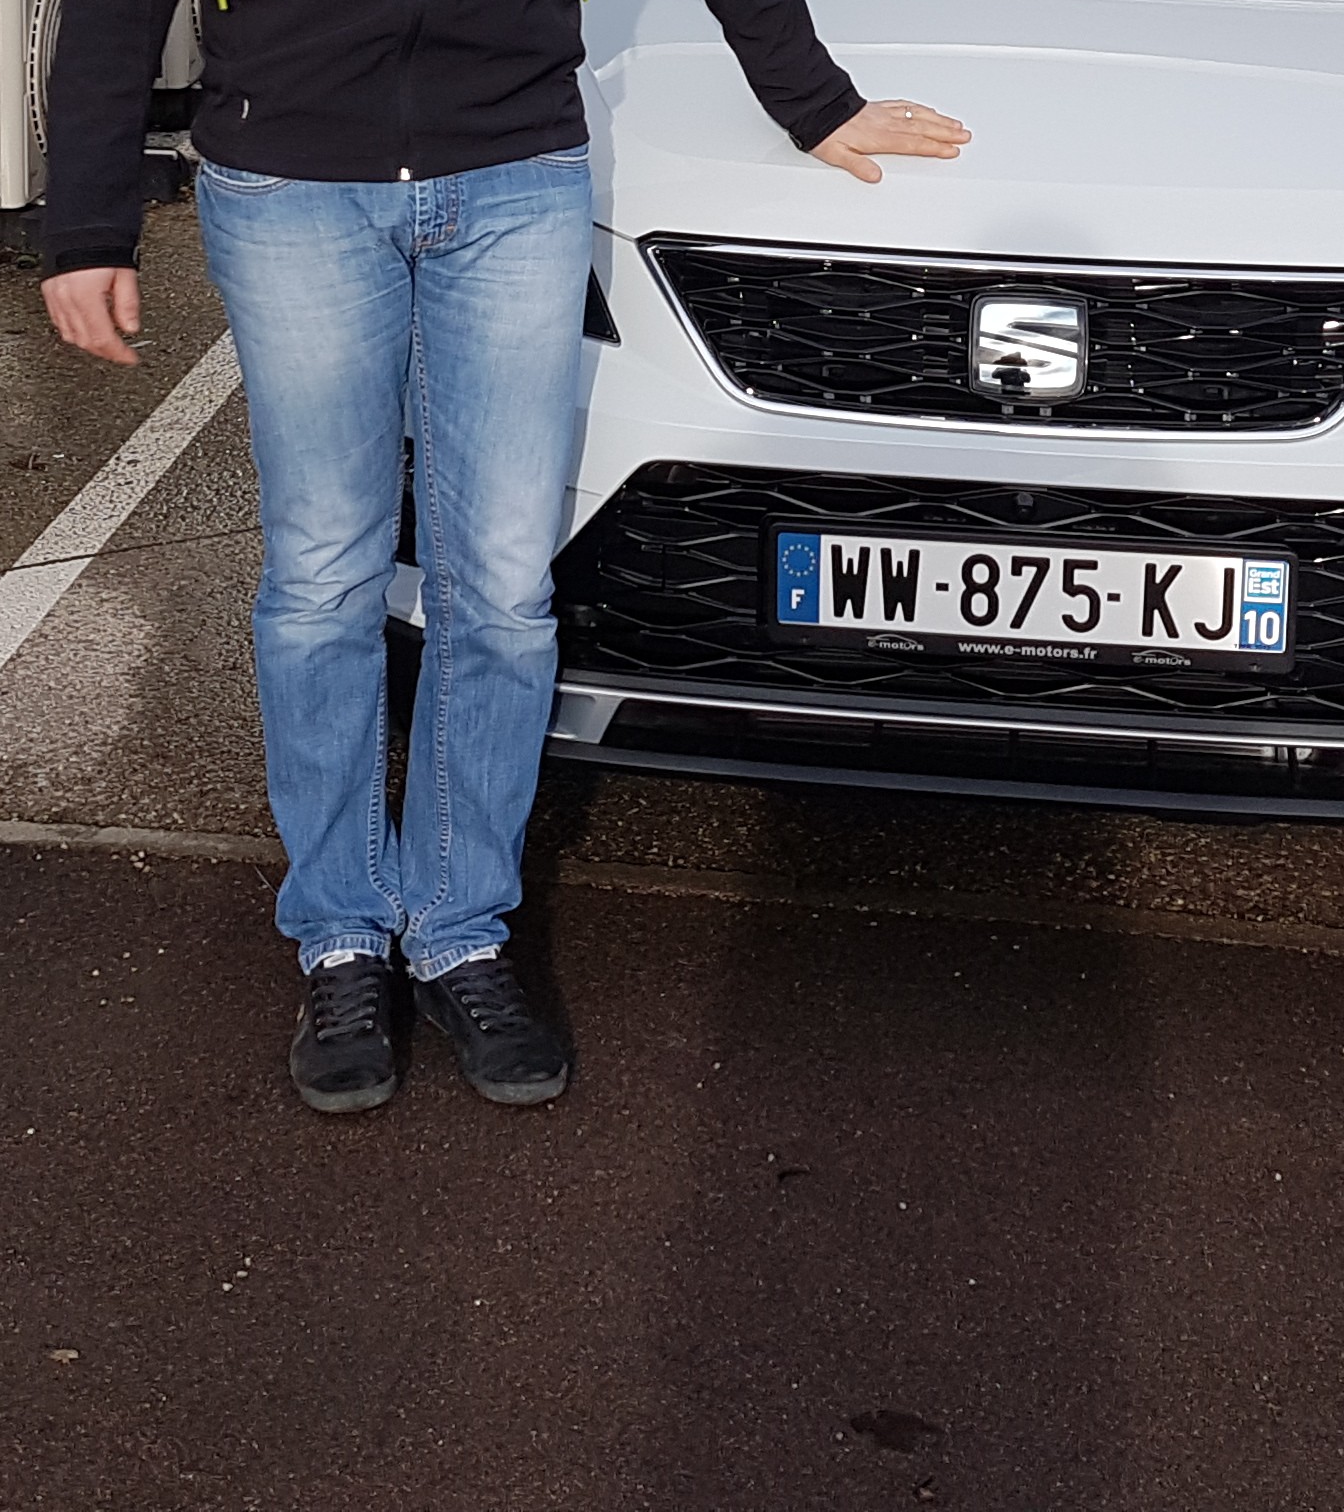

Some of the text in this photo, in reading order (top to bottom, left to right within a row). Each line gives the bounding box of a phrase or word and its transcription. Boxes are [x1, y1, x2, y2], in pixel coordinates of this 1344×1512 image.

[1249, 568, 1281, 579] Grand
[1248, 578, 1280, 595] Est
[791, 588, 805, 610] F
[1244, 609, 1280, 646] 10
[957, 641, 1098, 661] www.e-motors.fr
